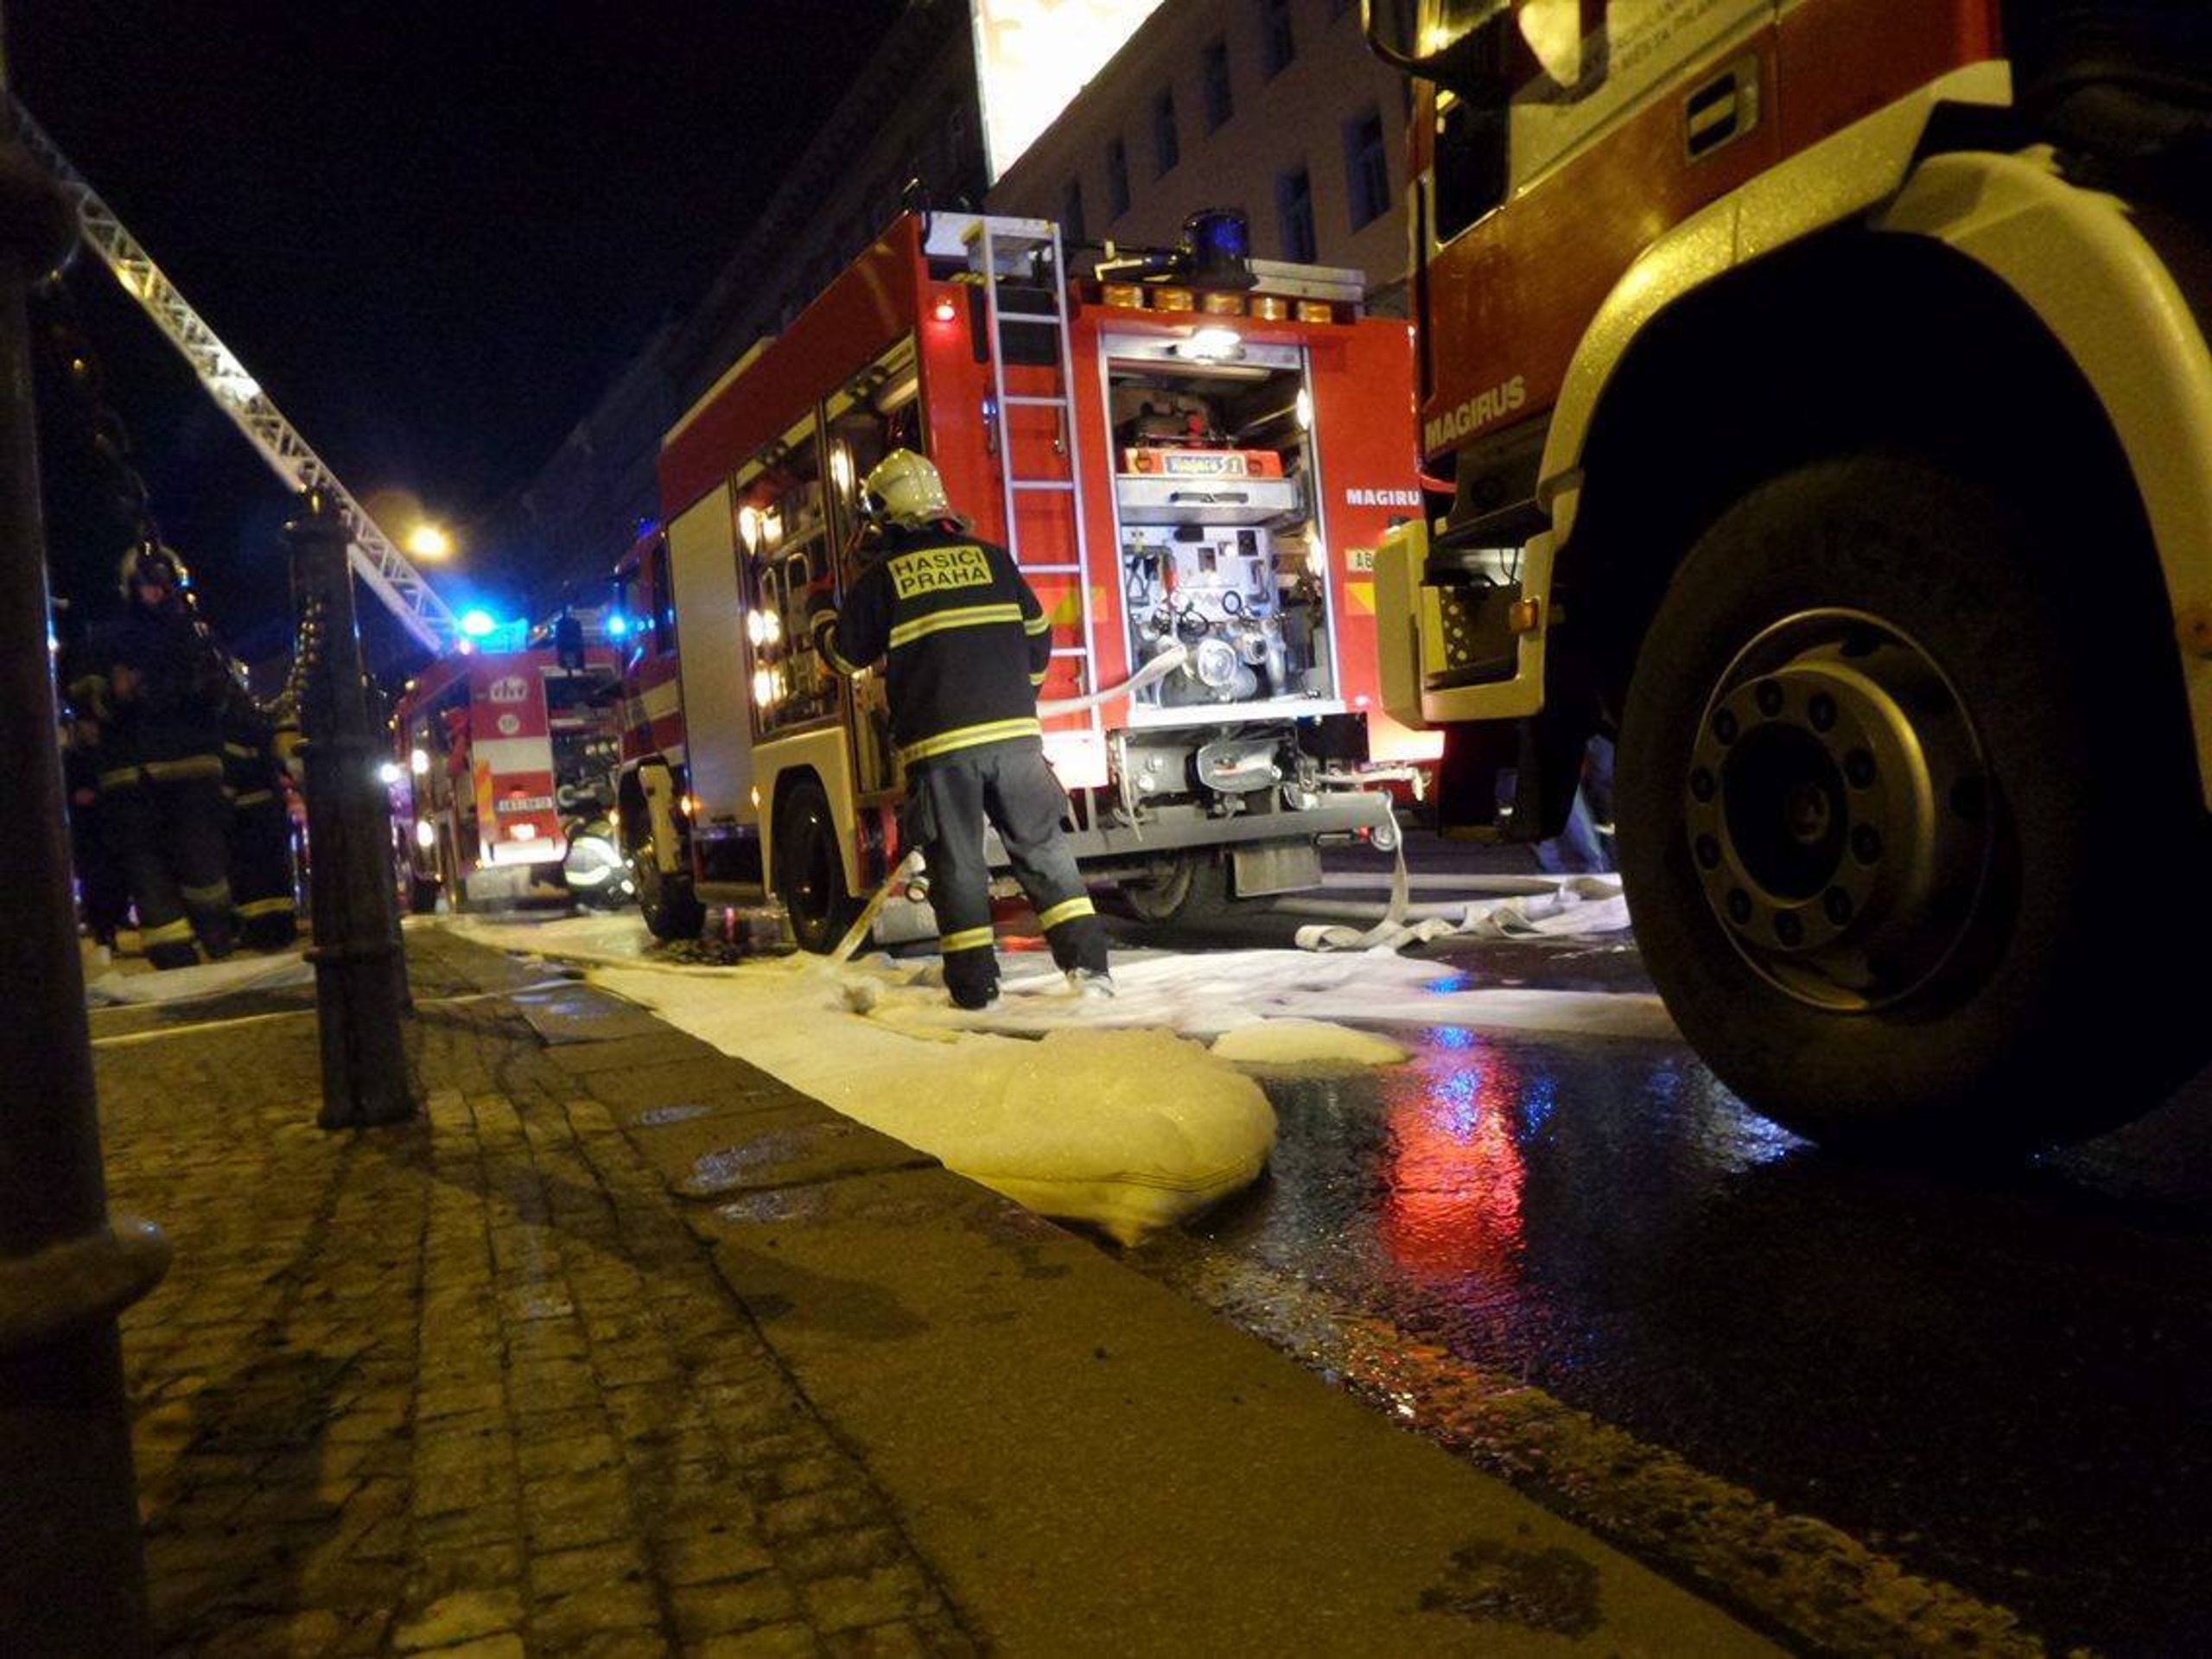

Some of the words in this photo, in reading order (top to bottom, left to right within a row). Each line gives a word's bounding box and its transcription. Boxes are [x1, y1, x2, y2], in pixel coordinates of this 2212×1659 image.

[1425, 374, 1526, 454] MAGIRUS
[1346, 489, 1421, 505] MAGIRU
[900, 566, 988, 594] PRAHA
